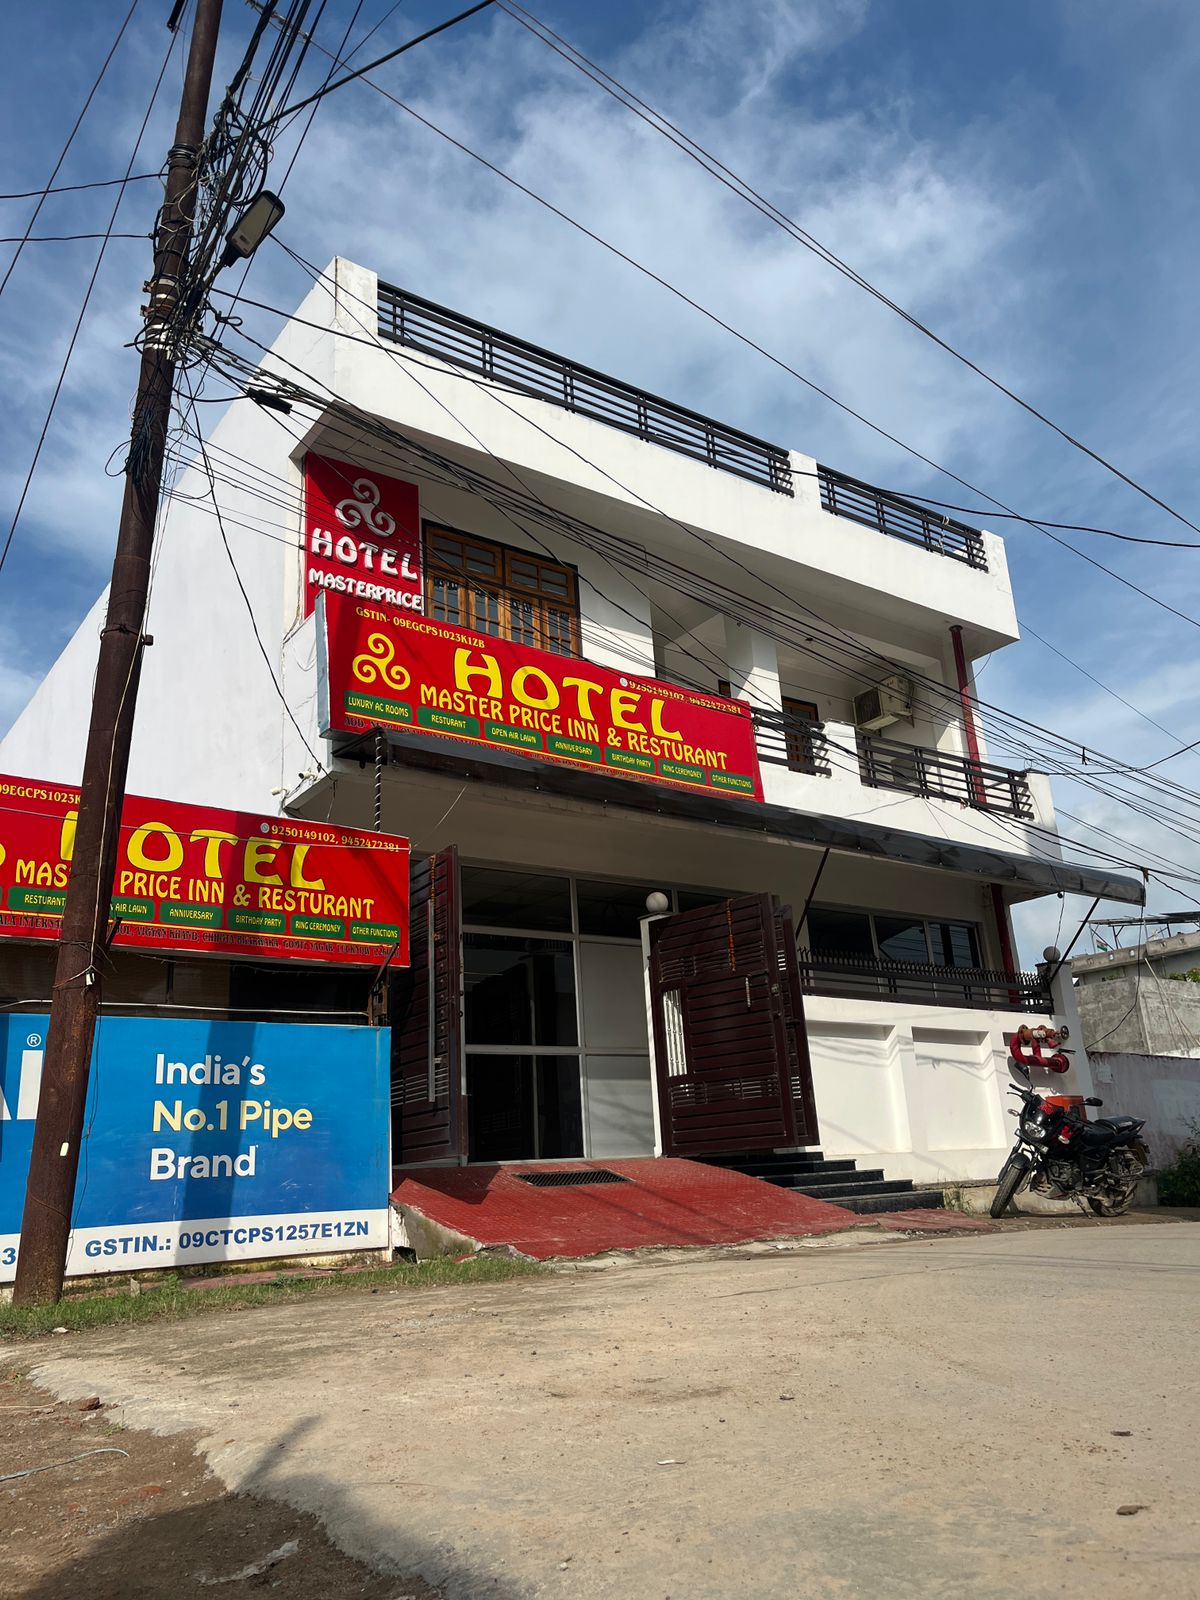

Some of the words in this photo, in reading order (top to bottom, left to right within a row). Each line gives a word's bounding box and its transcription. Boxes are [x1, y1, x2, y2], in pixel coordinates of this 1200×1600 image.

[311, 527, 418, 581] HOTEL
[308, 567, 423, 611] MASTERPRICE
[454, 647, 683, 741] HOTEL
[348, 696, 373, 709] LUXURY
[374, 702, 384, 712] AC
[385, 703, 409, 717] ROOMS
[420, 683, 504, 722] MASTER
[509, 703, 563, 735] PRICE
[568, 717, 600, 742] INN
[607, 727, 622, 747] &
[627, 731, 728, 770] RESTURANT
[431, 714, 466, 729] RESTURANT
[491, 727, 508, 737] OPEN
[508, 730, 519, 740] AIR
[520, 733, 537, 744] LAWN
[555, 741, 593, 756] ANNIVERSARY
[611, 753, 636, 765] BIRTHDAY
[636, 757, 651, 768] PARTY
[663, 763, 675, 774] RING
[711, 774, 727, 784] OTHER
[727, 776, 752, 789] FUNCTIONS
[15, 858, 71, 888] MAS
[119, 870, 182, 900] PRICE
[188, 878, 225, 904] INN
[232, 884, 251, 907] &
[258, 886, 375, 920] RESTURANT
[115, 902, 127, 913] AIR
[128, 903, 147, 914] LAWN
[169, 908, 213, 921] ANNIVERSARY
[235, 914, 263, 926] BIRTHDAY
[264, 917, 282, 928] PARTY
[295, 920, 309, 930] RING
[309, 921, 341, 933] CEREMONEY
[352, 926, 369, 935] OTHER
[370, 928, 398, 938] FUNCTIONS
[152, 1100, 229, 1132] No.1
[239, 1100, 313, 1139] Pipe
[150, 1145, 257, 1181] Brand
[85, 1235, 172, 1258] GSTIN.:
[178, 1220, 370, 1249] 09CTCPS1257E1ZN
